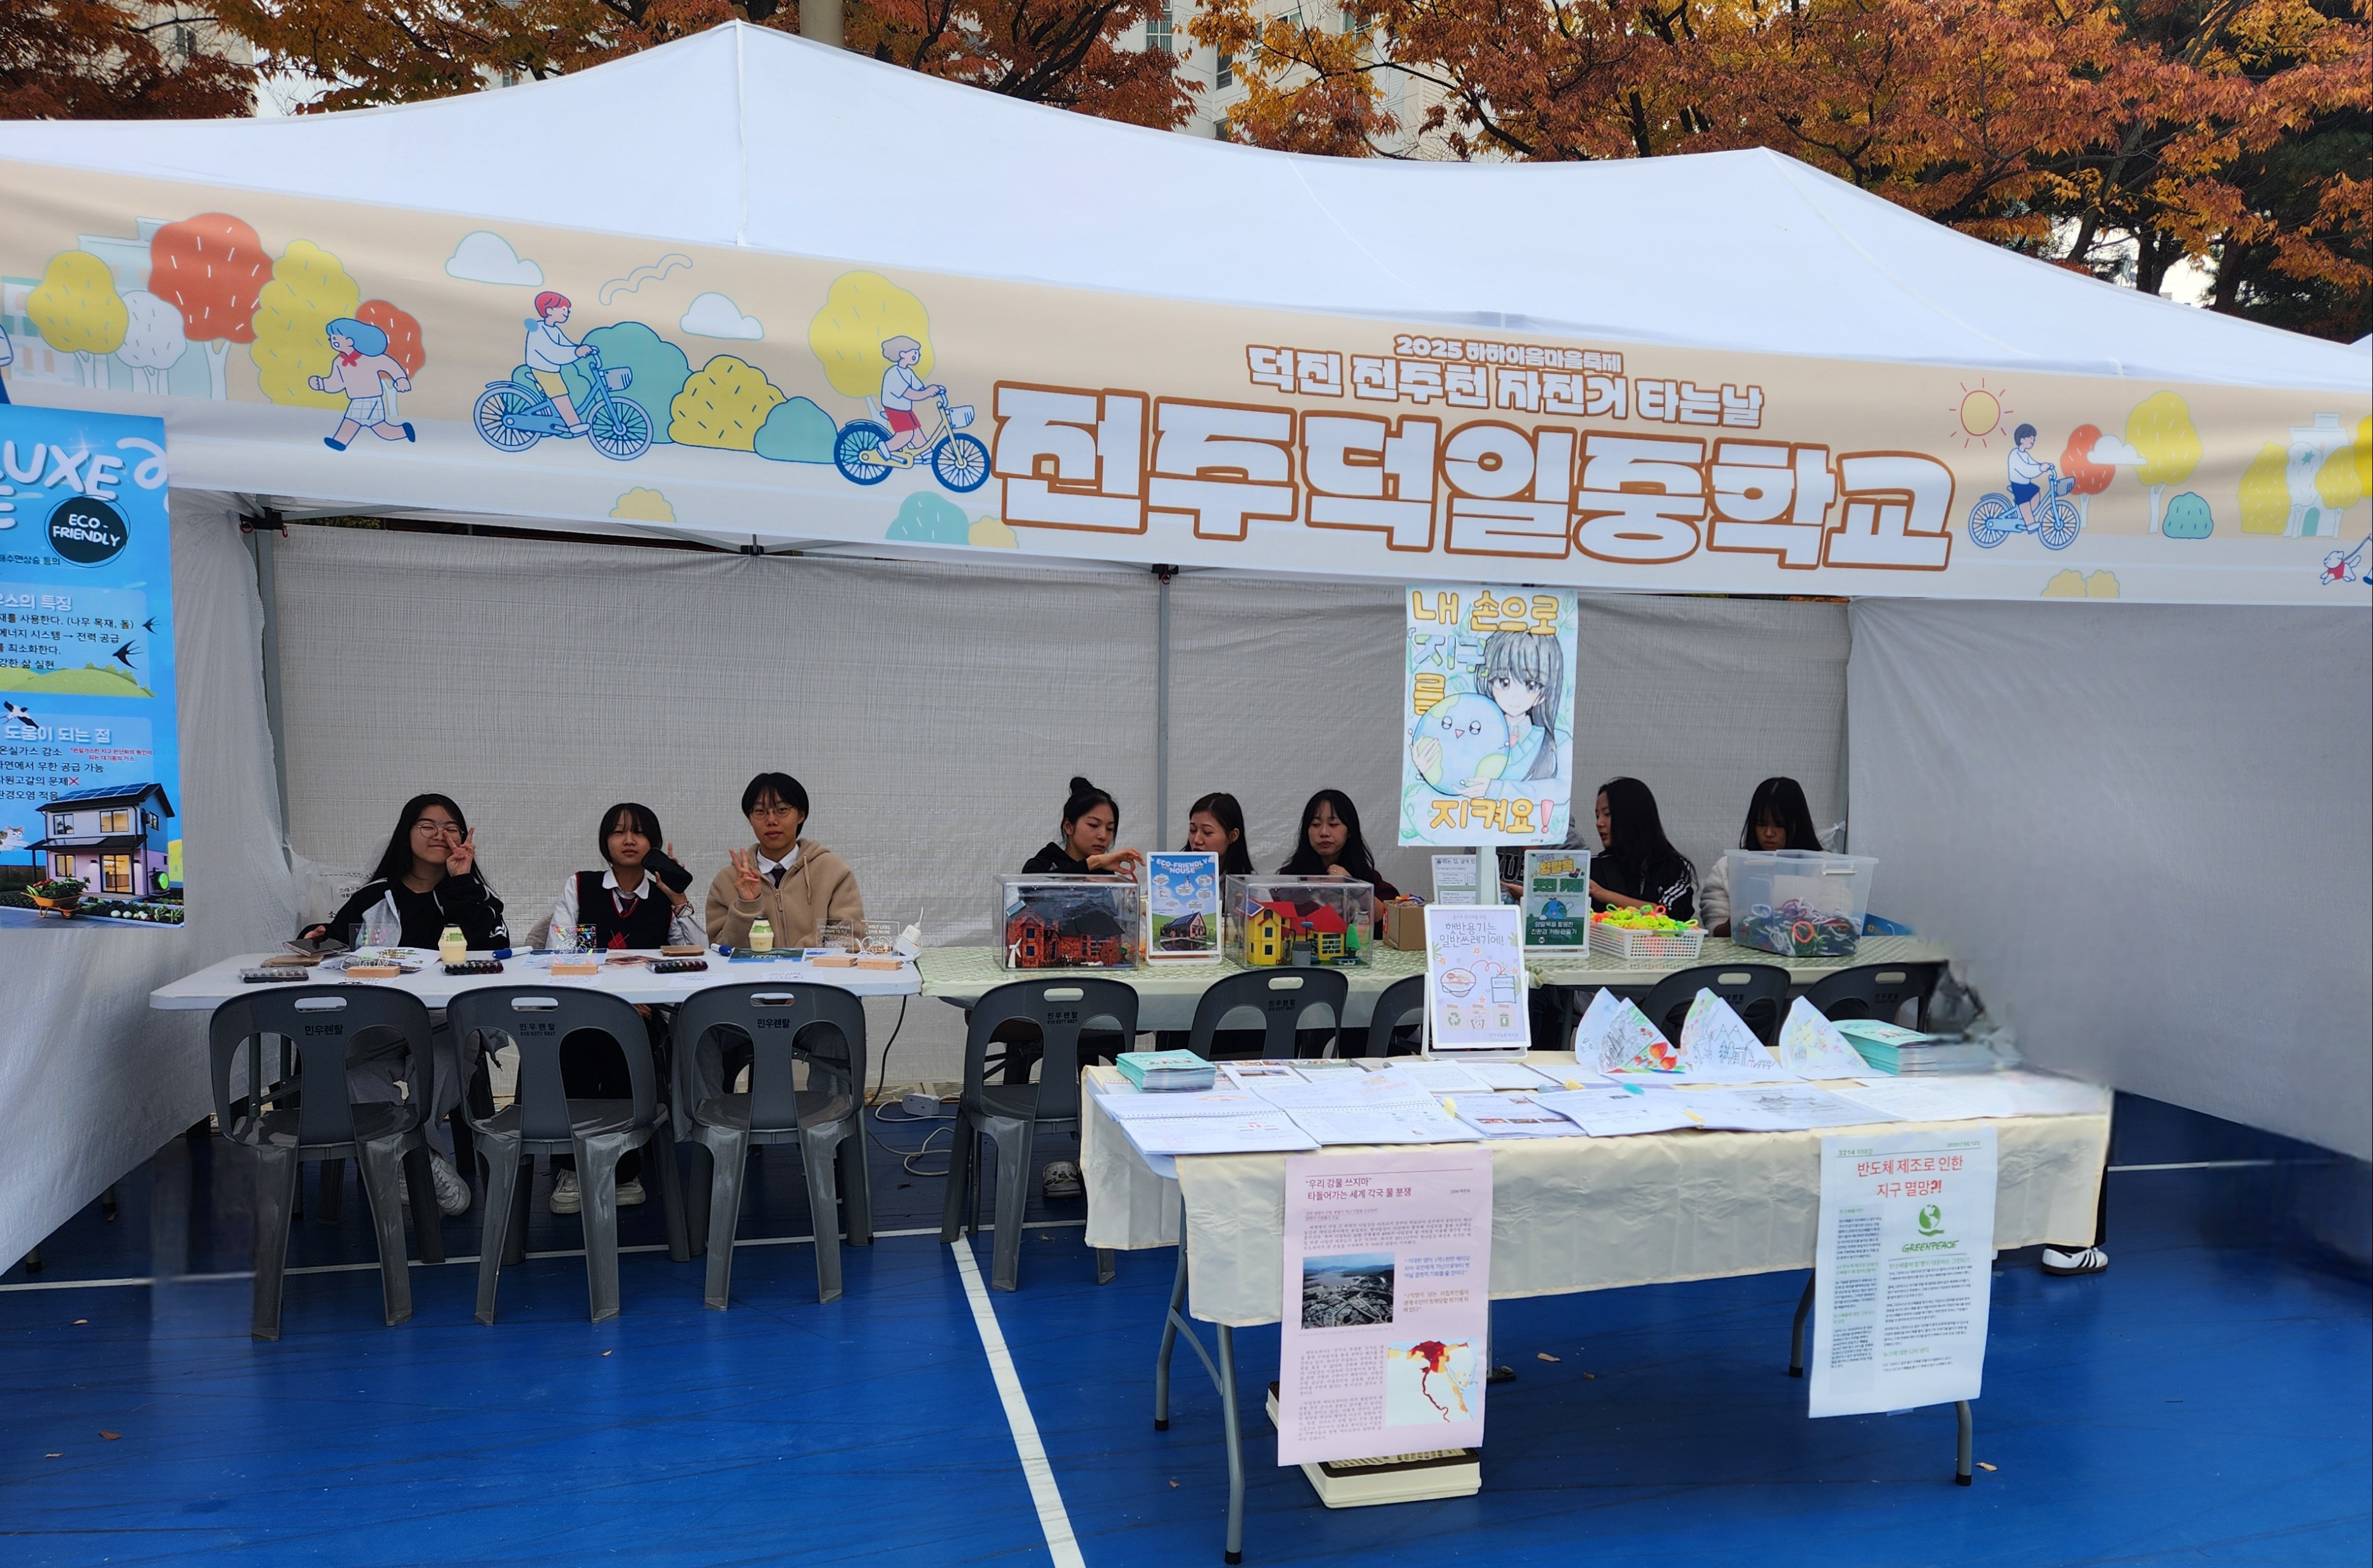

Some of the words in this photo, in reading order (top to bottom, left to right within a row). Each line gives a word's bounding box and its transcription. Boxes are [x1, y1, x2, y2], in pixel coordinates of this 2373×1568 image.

[1393, 333, 1464, 360] 2025
[1464, 339, 1623, 375] 하하이음마을축제
[1246, 344, 1343, 397] 덕진
[1351, 354, 1490, 409] 전주천
[1496, 366, 1628, 421] 자전거
[1635, 378, 1764, 429] 타는날
[0, 440, 125, 501] UXE
[992, 380, 1955, 571] 전주덕일중학교
[53, 525, 120, 547] FRIENDLY
[41, 595, 73, 611] 특징
[20, 614, 63, 625] 사용한다.
[1412, 590, 1459, 625] 내
[1470, 590, 1560, 635] 손으로
[30, 630, 60, 641] 시스템
[77, 633, 96, 642] 전력
[100, 633, 120, 644] 공급
[8, 644, 61, 655] 최소화한다.
[1414, 635, 1488, 673] 지구
[35, 660, 54, 669] 실현
[1413, 673, 1445, 716] 를
[4, 725, 53, 742] 도움이
[58, 727, 91, 743] 되는
[96, 728, 112, 744] 점
[0, 745, 39, 756] 온실가스
[42, 747, 63, 756] 감소
[37, 762, 58, 772] 무한
[61, 762, 81, 772] 공급
[84, 763, 104, 773] 가능
[49, 776, 69, 787] 문제
[39, 791, 59, 802] 적음
[1430, 798, 1555, 835] 지켜요!
[1156, 858, 1209, 869] ECO-FRIENDLY
[1445, 922, 1497, 935] 햇반용기는
[1440, 935, 1504, 948] 일반쓰레기에!
[304, 1024, 344, 1036] 민우렌탈
[757, 1018, 790, 1029] 민우렌탈
[1858, 1160, 1894, 1178] 반도체
[1897, 1157, 1936, 1174] 제조로
[1938, 1155, 1964, 1171] 인한
[1327, 1178, 1342, 1188] 강물
[1877, 1183, 1902, 1198] 지구
[1905, 1179, 1942, 1197] 멸망?!
[1307, 1190, 1347, 1201] 타들어가는
[1350, 1189, 1366, 1198] 세계
[1367, 1188, 1383, 1198] 각국
[1395, 1187, 1412, 1197] 분쟁
[1902, 1240, 1959, 1254] GREENPEACE
